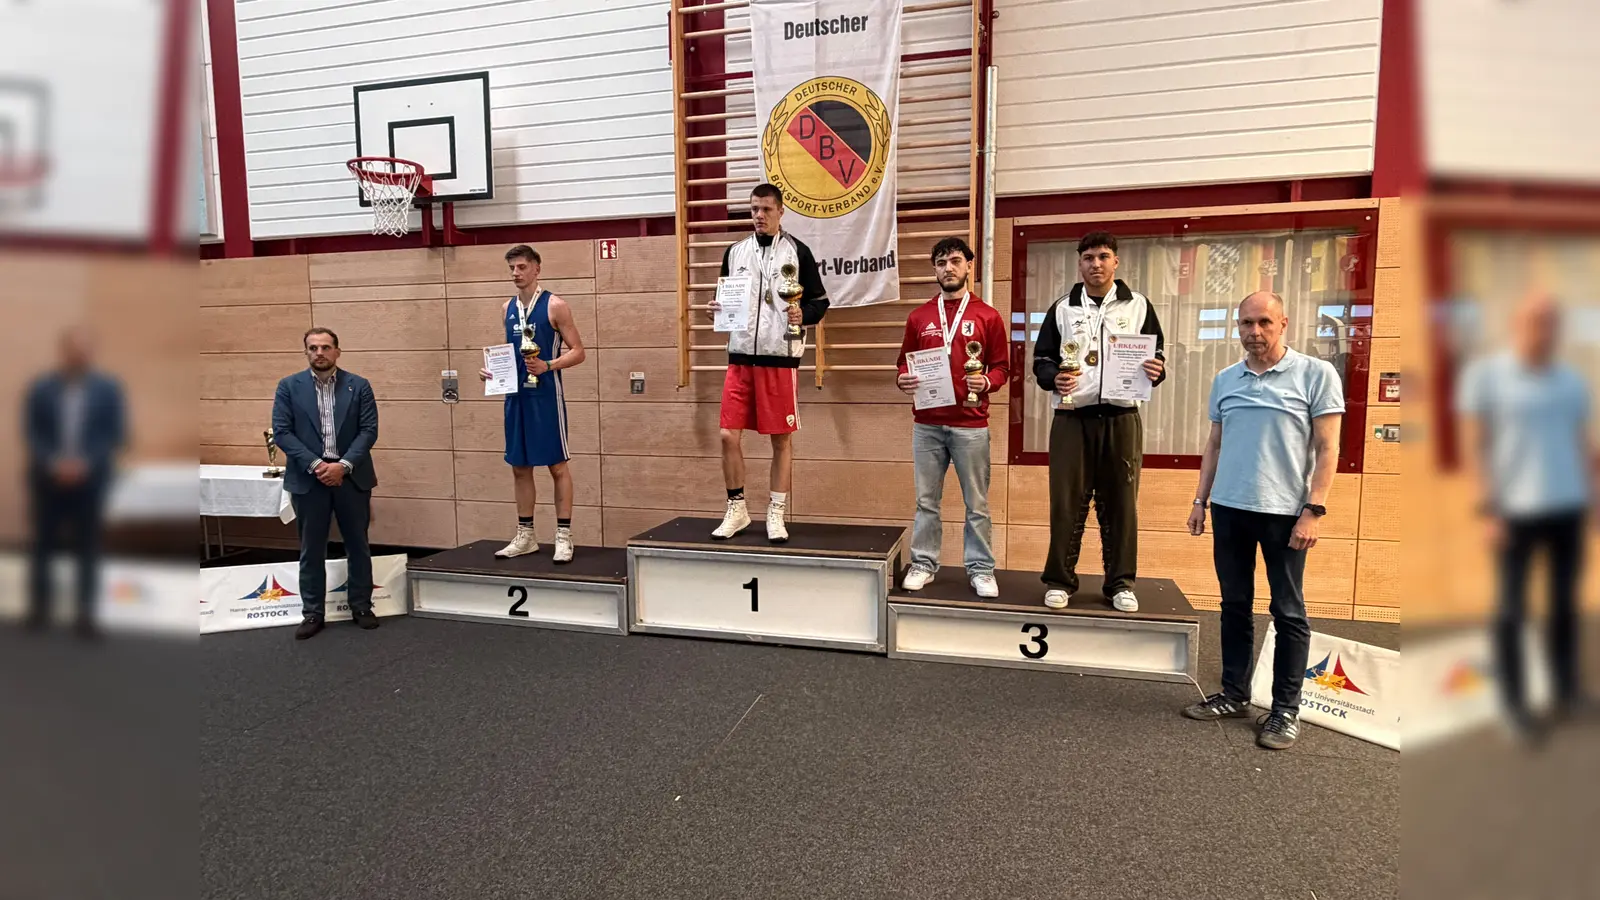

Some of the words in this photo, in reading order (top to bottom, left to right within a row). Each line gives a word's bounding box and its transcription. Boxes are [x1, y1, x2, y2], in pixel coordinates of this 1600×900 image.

[784, 15, 868, 40] Deutscher
[794, 81, 858, 102] DEUTSCHER
[770, 174, 872, 213] BOXSPORT-VERBAND
[815, 250, 896, 276] rt-Verband
[507, 585, 530, 617] 2
[742, 577, 759, 612] 1
[246, 609, 289, 619] ROSTOCK
[1018, 622, 1049, 659] 3
[1300, 698, 1349, 719] OSTOCK
[1314, 691, 1376, 716] Universitätsstadt
